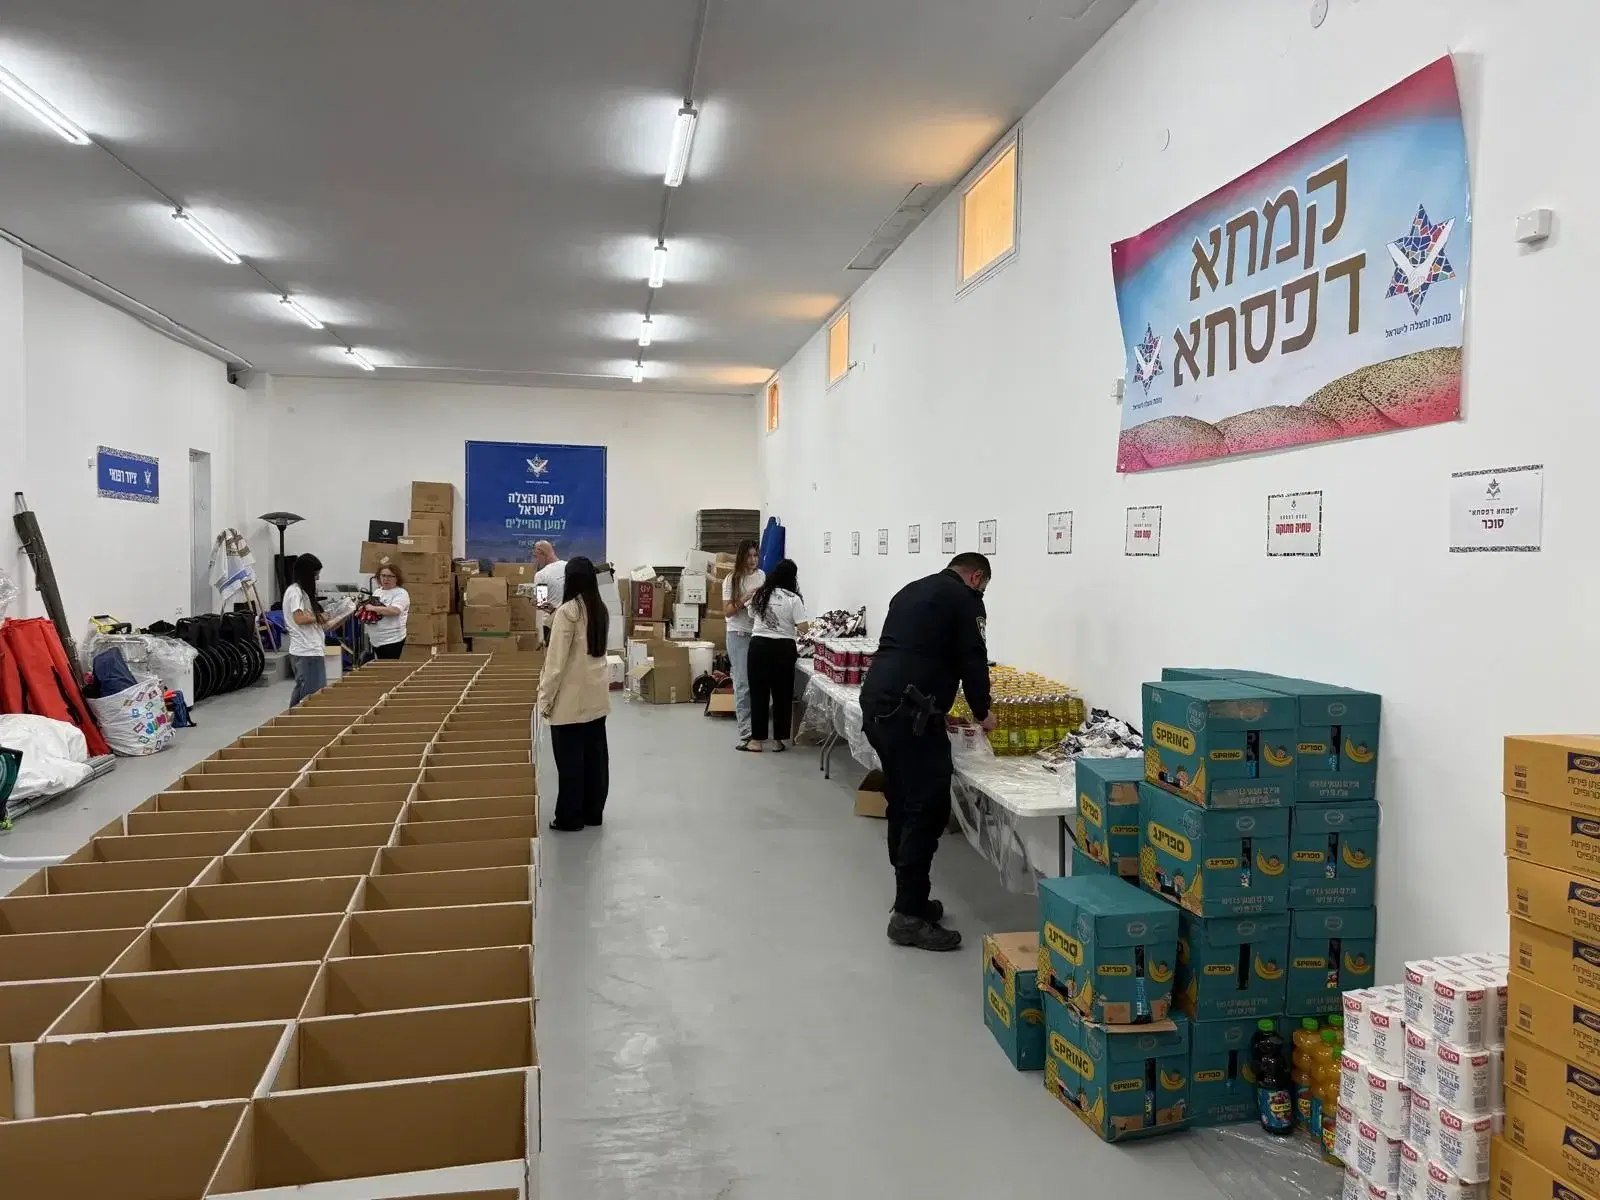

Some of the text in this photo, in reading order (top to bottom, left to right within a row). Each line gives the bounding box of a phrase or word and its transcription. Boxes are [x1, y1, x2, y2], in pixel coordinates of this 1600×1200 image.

[1189, 155, 1348, 301] קמחא
[1173, 250, 1366, 388] דפסחא
[1385, 312, 1452, 338] נחמה והצלה לישראל
[508, 491, 565, 505] נחמה והצלה
[518, 503, 555, 516] לישראל
[505, 517, 567, 531] למען החיילים
[1481, 518, 1504, 529] סוכר
[1156, 727, 1189, 750] SPRING
[1212, 751, 1241, 759] SPRING
[1567, 776, 1588, 787] פירות
[1153, 827, 1185, 853] ספרינג
[1571, 839, 1591, 851] פירות
[1048, 928, 1078, 957] ספרינג
[1054, 1039, 1089, 1074] SPRING
[1437, 1066, 1459, 1081] WHITE
[1113, 1082, 1139, 1091] SPRING
[1437, 1073, 1459, 1090] SUGAR
